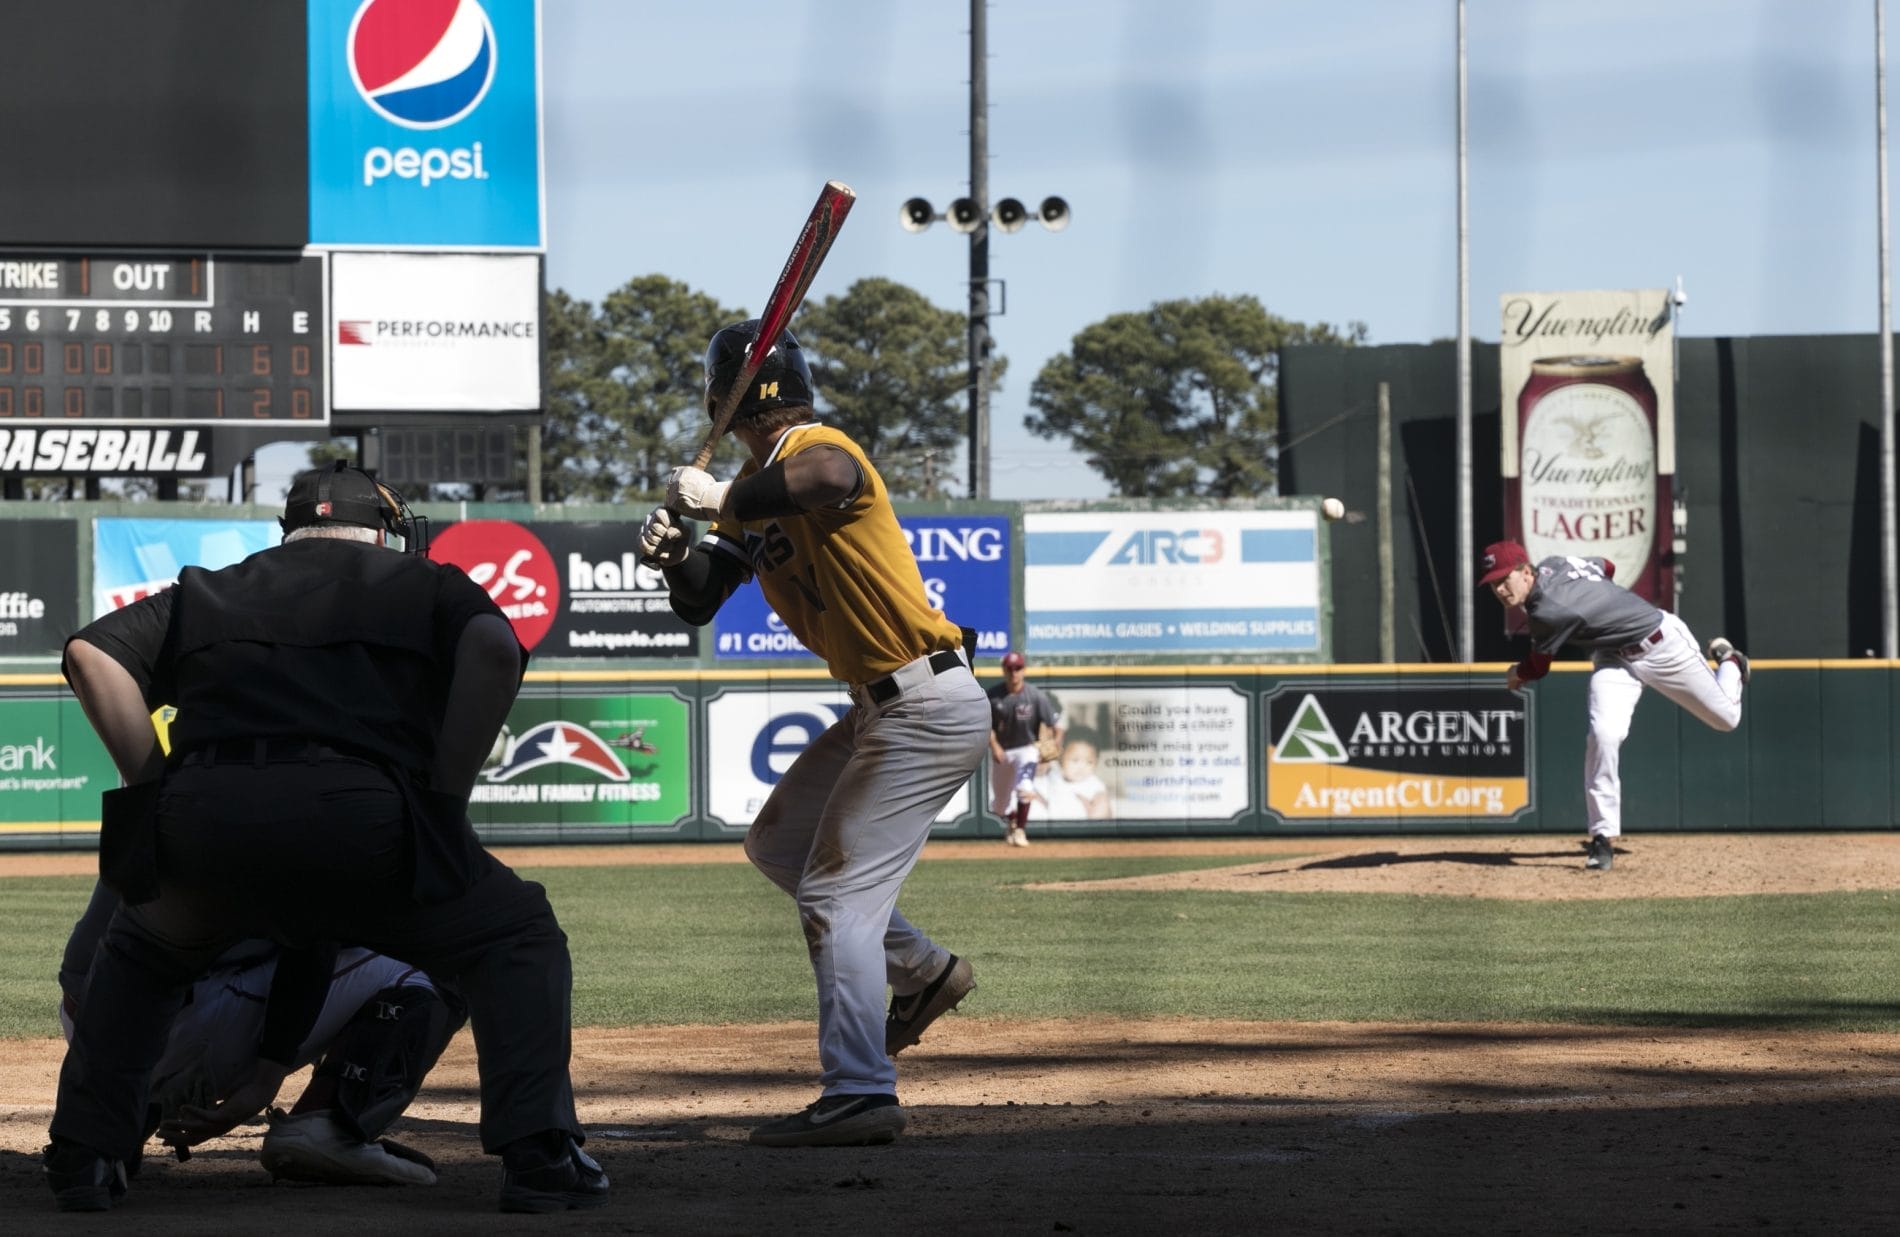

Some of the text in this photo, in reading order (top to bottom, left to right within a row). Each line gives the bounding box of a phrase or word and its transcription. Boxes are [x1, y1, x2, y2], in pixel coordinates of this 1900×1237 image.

[363, 141, 484, 187] pepsi
[113, 264, 170, 290] OUT
[25, 310, 40, 332] 6
[66, 310, 82, 332] 7
[96, 310, 110, 332] 8
[124, 310, 139, 332] 9
[149, 310, 172, 332] 10
[194, 311, 213, 332] R
[243, 312, 260, 333] H
[293, 311, 309, 333] E
[377, 321, 534, 338] PERFORMANCE
[1501, 299, 1669, 348] Yuengling
[24, 343, 43, 374] 0
[64, 343, 84, 374] 0
[93, 343, 112, 375] 0
[253, 345, 271, 376] 6
[292, 345, 310, 376] 0
[759, 381, 779, 399] 14
[24, 386, 43, 417] 0
[64, 386, 84, 417] 0
[253, 388, 271, 418] 2
[292, 388, 310, 418] 0
[1523, 448, 1651, 490] Yuengling
[1541, 494, 1638, 509] TRADITIONAL
[1532, 507, 1646, 541] LAGER
[1107, 529, 1224, 566] ARC3
[568, 552, 670, 591] hale
[569, 599, 644, 613] AUTOMOTIVE
[1029, 620, 1315, 639] INDUSTRIAL GASES WELDING SUPPLIES
[719, 632, 742, 651] #1
[1118, 703, 1229, 718] Could you have
[1180, 721, 1188, 731] a
[1191, 719, 1233, 732] child?
[1350, 711, 1516, 743] ARGENT
[1163, 741, 1192, 752] miss
[1198, 743, 1230, 755] your
[1350, 743, 1512, 758] CREDIT UNION
[1104, 755, 1154, 768] chance
[1159, 755, 1174, 767] to
[1178, 755, 1193, 767] be
[1199, 757, 1208, 767] a
[541, 783, 596, 802] FAMILY
[598, 782, 661, 802] FITNESS
[1294, 780, 1504, 814] ArgentCU.org
